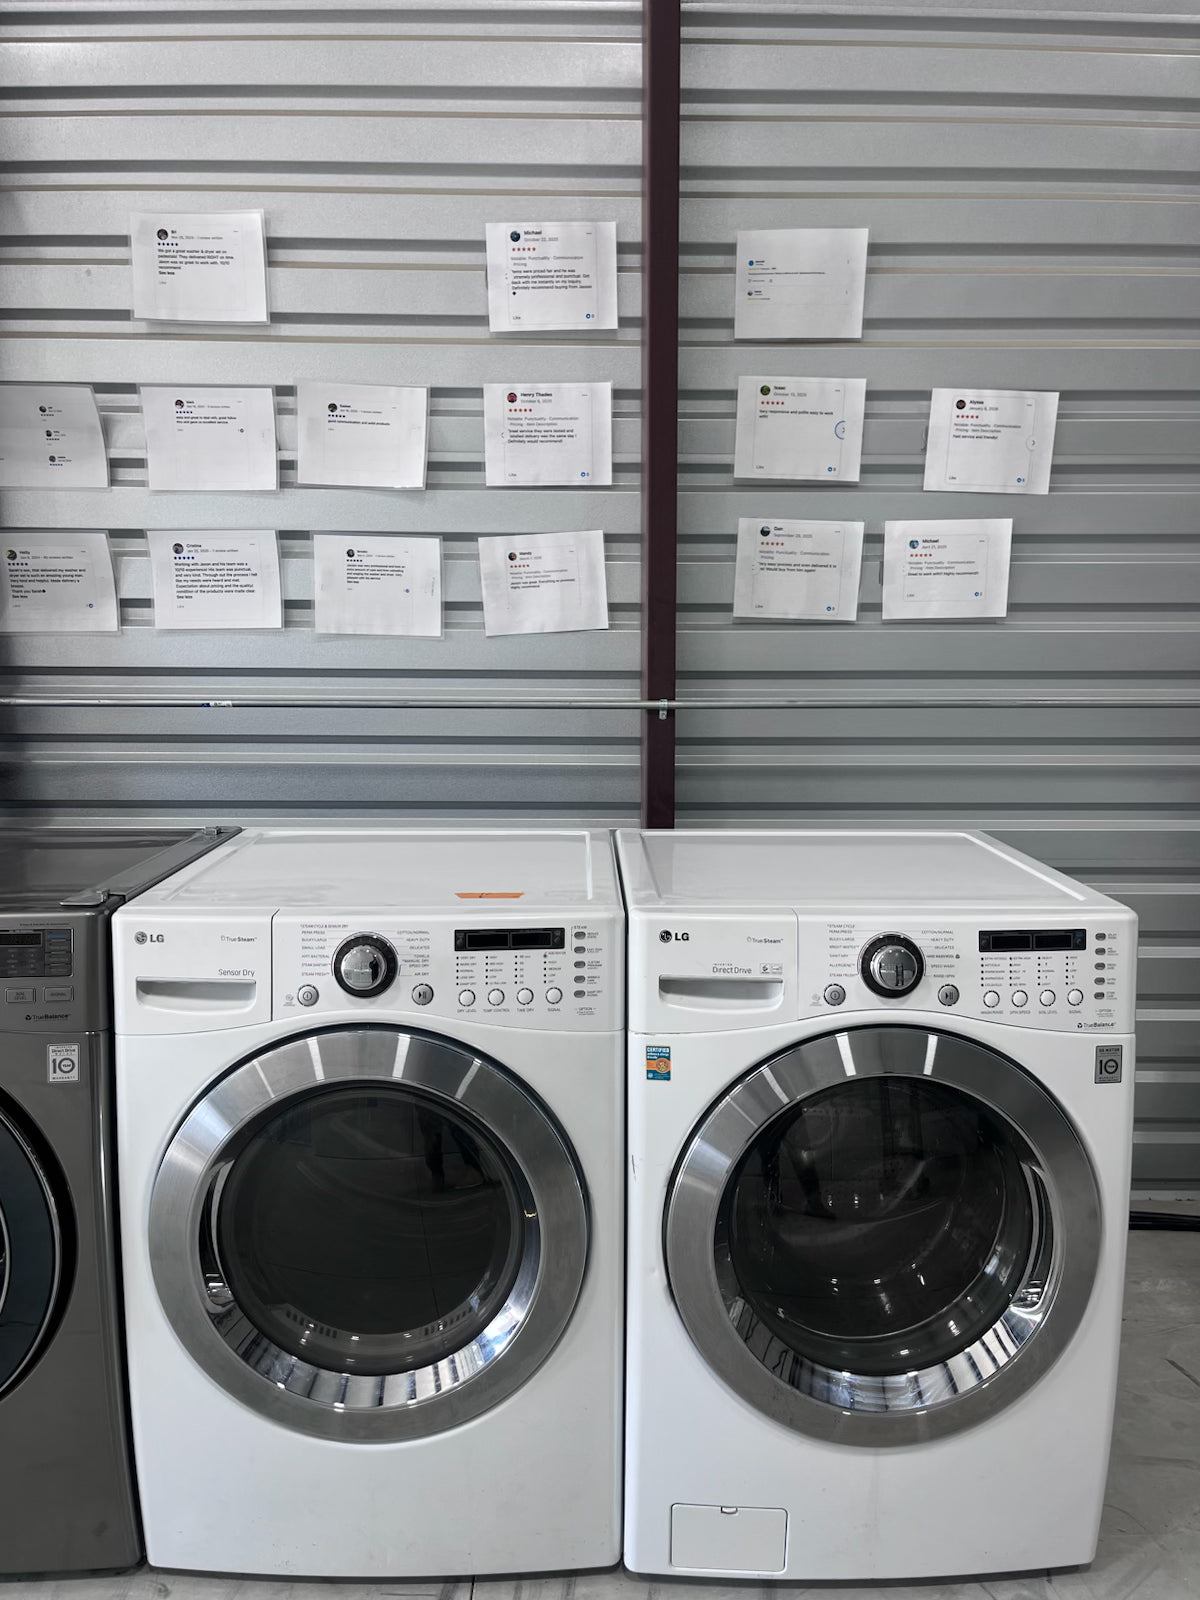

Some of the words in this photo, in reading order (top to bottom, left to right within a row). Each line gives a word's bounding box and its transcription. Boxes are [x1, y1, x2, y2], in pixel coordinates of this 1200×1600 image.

[150, 934, 164, 943] LG
[675, 933, 689, 941] LG
[243, 969, 255, 978] Dry
